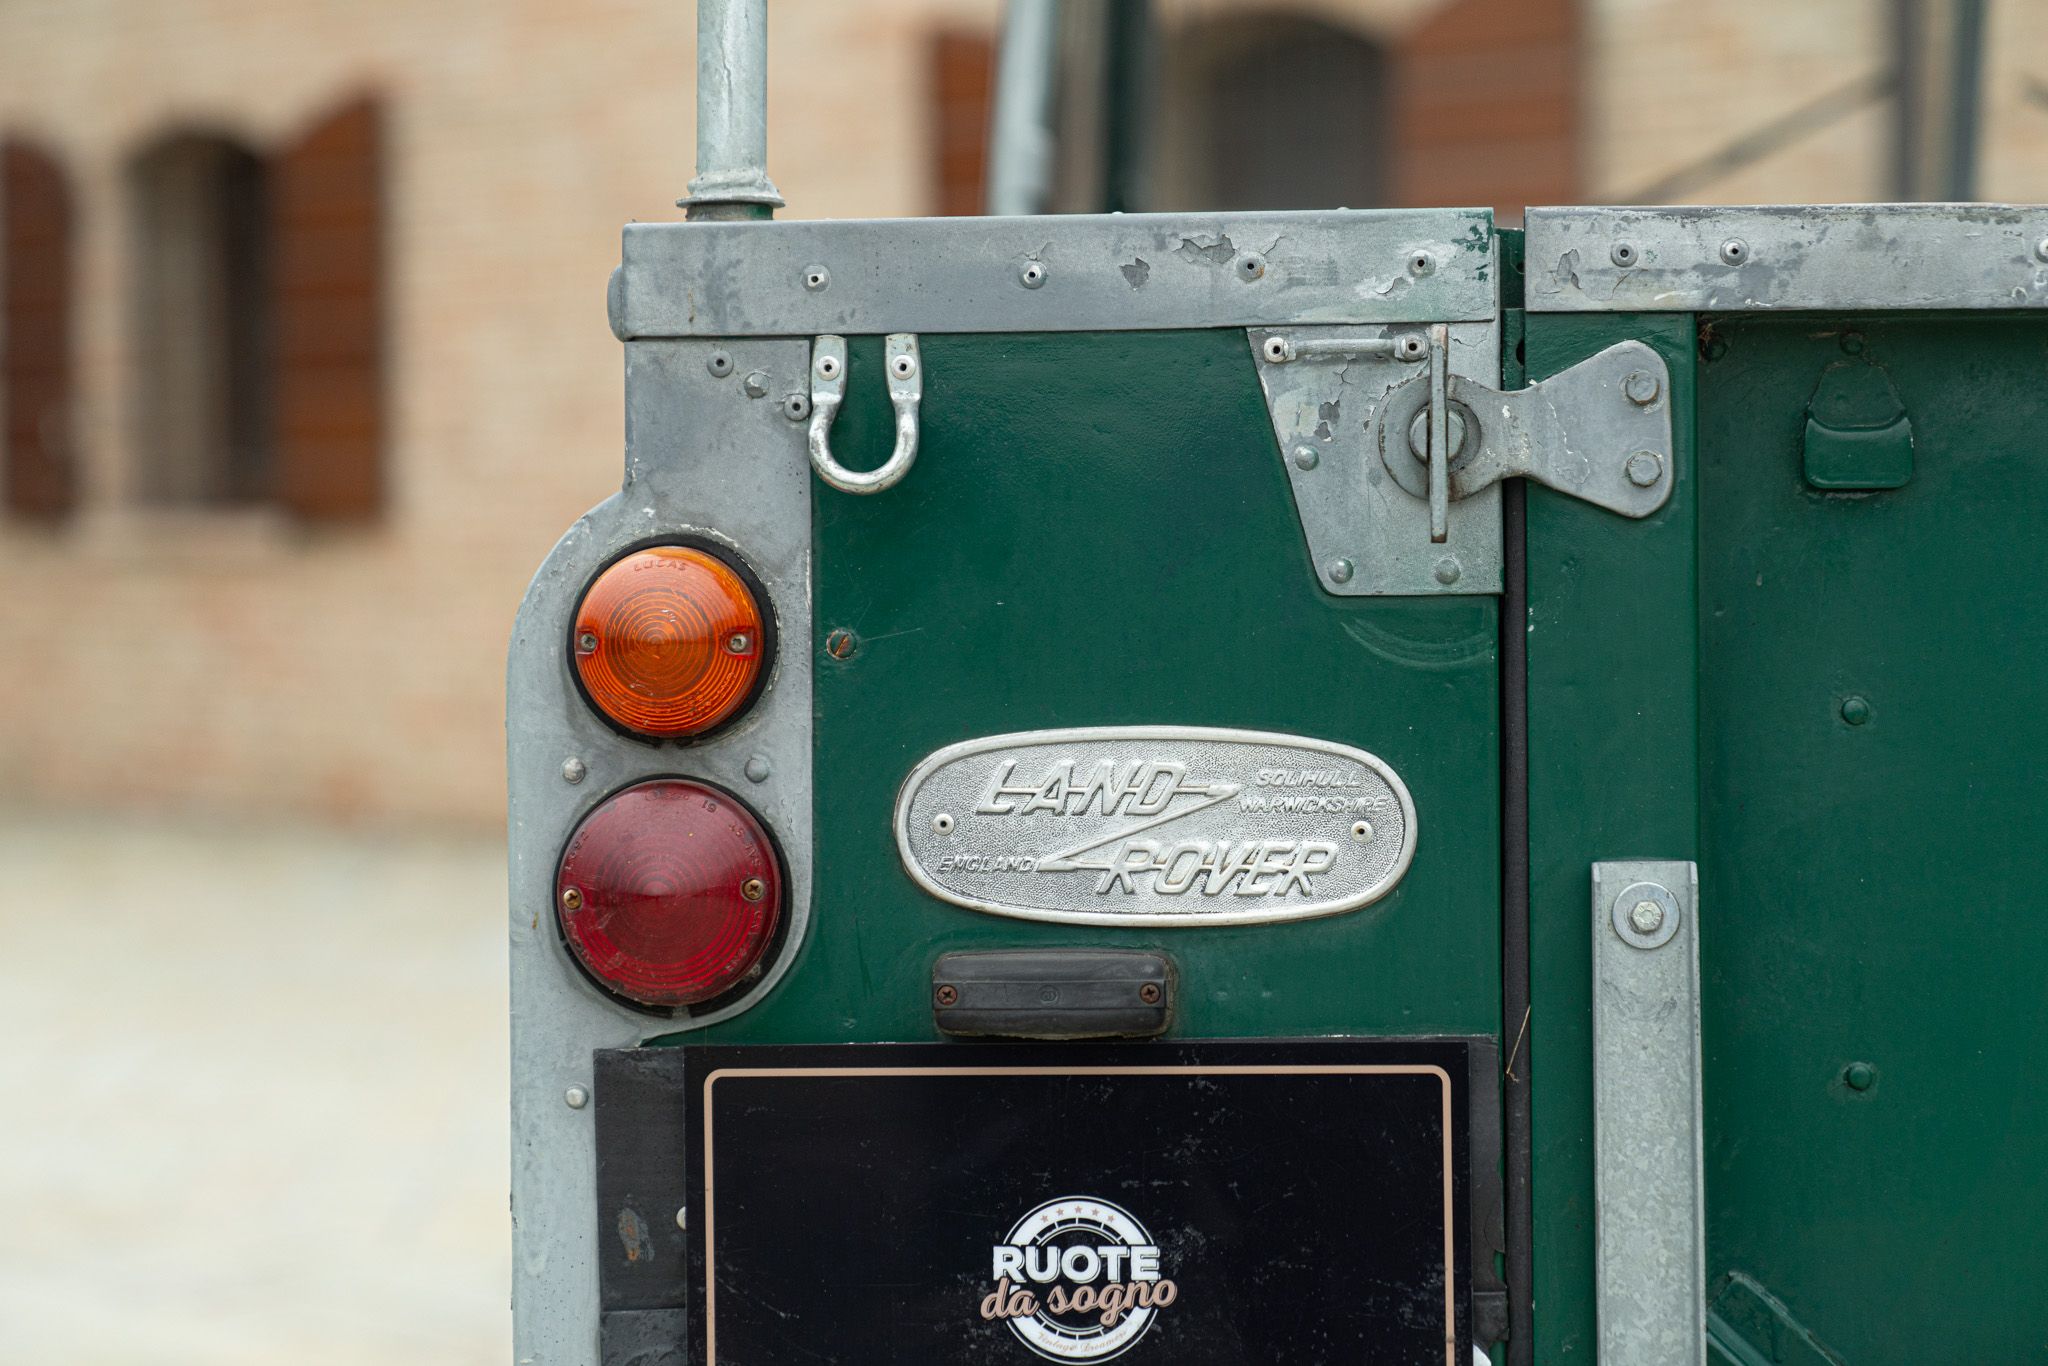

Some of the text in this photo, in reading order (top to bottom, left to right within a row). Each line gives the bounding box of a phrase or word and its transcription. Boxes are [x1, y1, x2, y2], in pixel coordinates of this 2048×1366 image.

[633, 558, 690, 573] LUCAS
[976, 758, 1186, 816] LAND
[1256, 768, 1361, 788] SOLIHULL
[1238, 796, 1388, 815] WARWICKSHIRE
[936, 855, 1036, 874] ENGLAND
[1096, 839, 1338, 897] ROVER
[992, 1245, 1161, 1283] RUOTE
[980, 1277, 1178, 1327] da sogno
